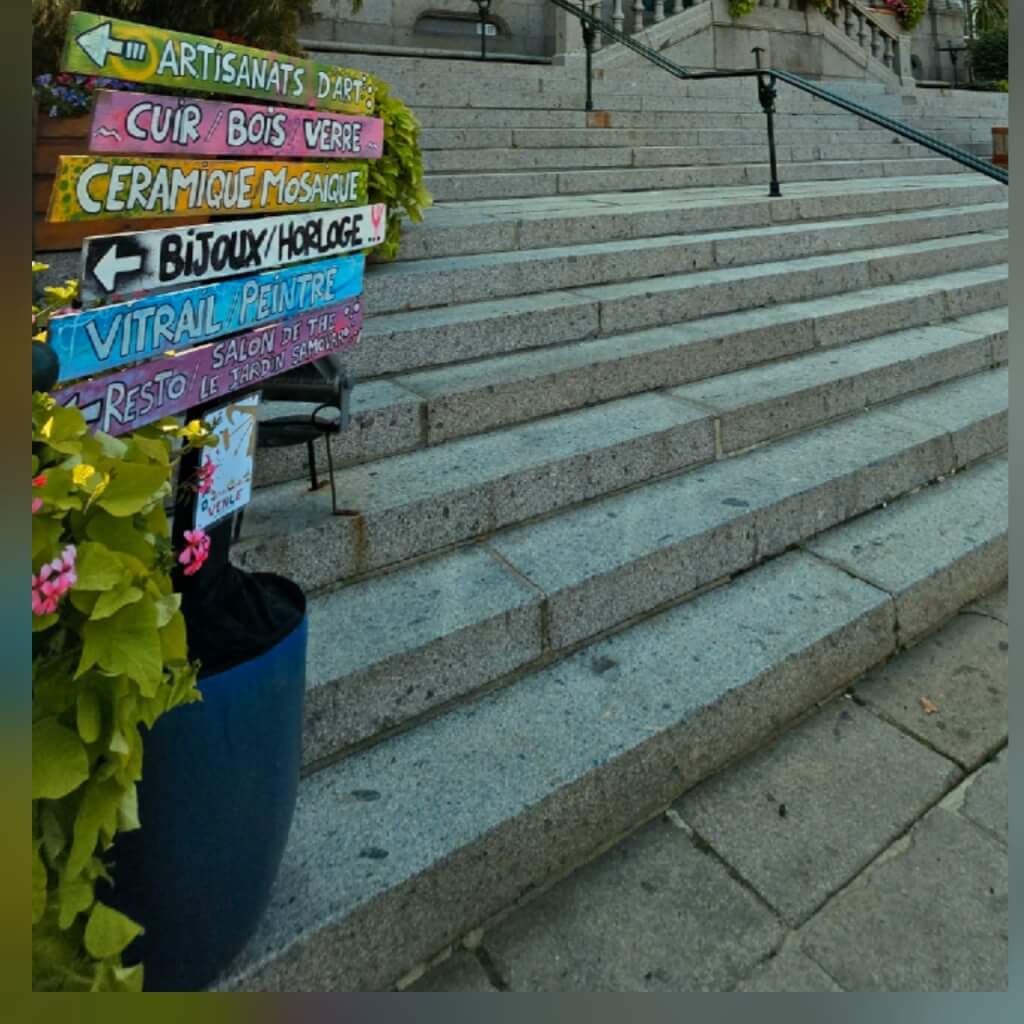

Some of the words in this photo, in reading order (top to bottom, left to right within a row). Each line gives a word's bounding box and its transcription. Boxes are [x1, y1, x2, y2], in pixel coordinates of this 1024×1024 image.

[304, 118, 361, 154] VERRE
[212, 327, 277, 369] SALON
[282, 320, 302, 346] DE
[308, 312, 337, 338] THE
[102, 368, 188, 434] RESTO
[200, 375, 220, 400] LE
[230, 352, 285, 392] JARDIN
